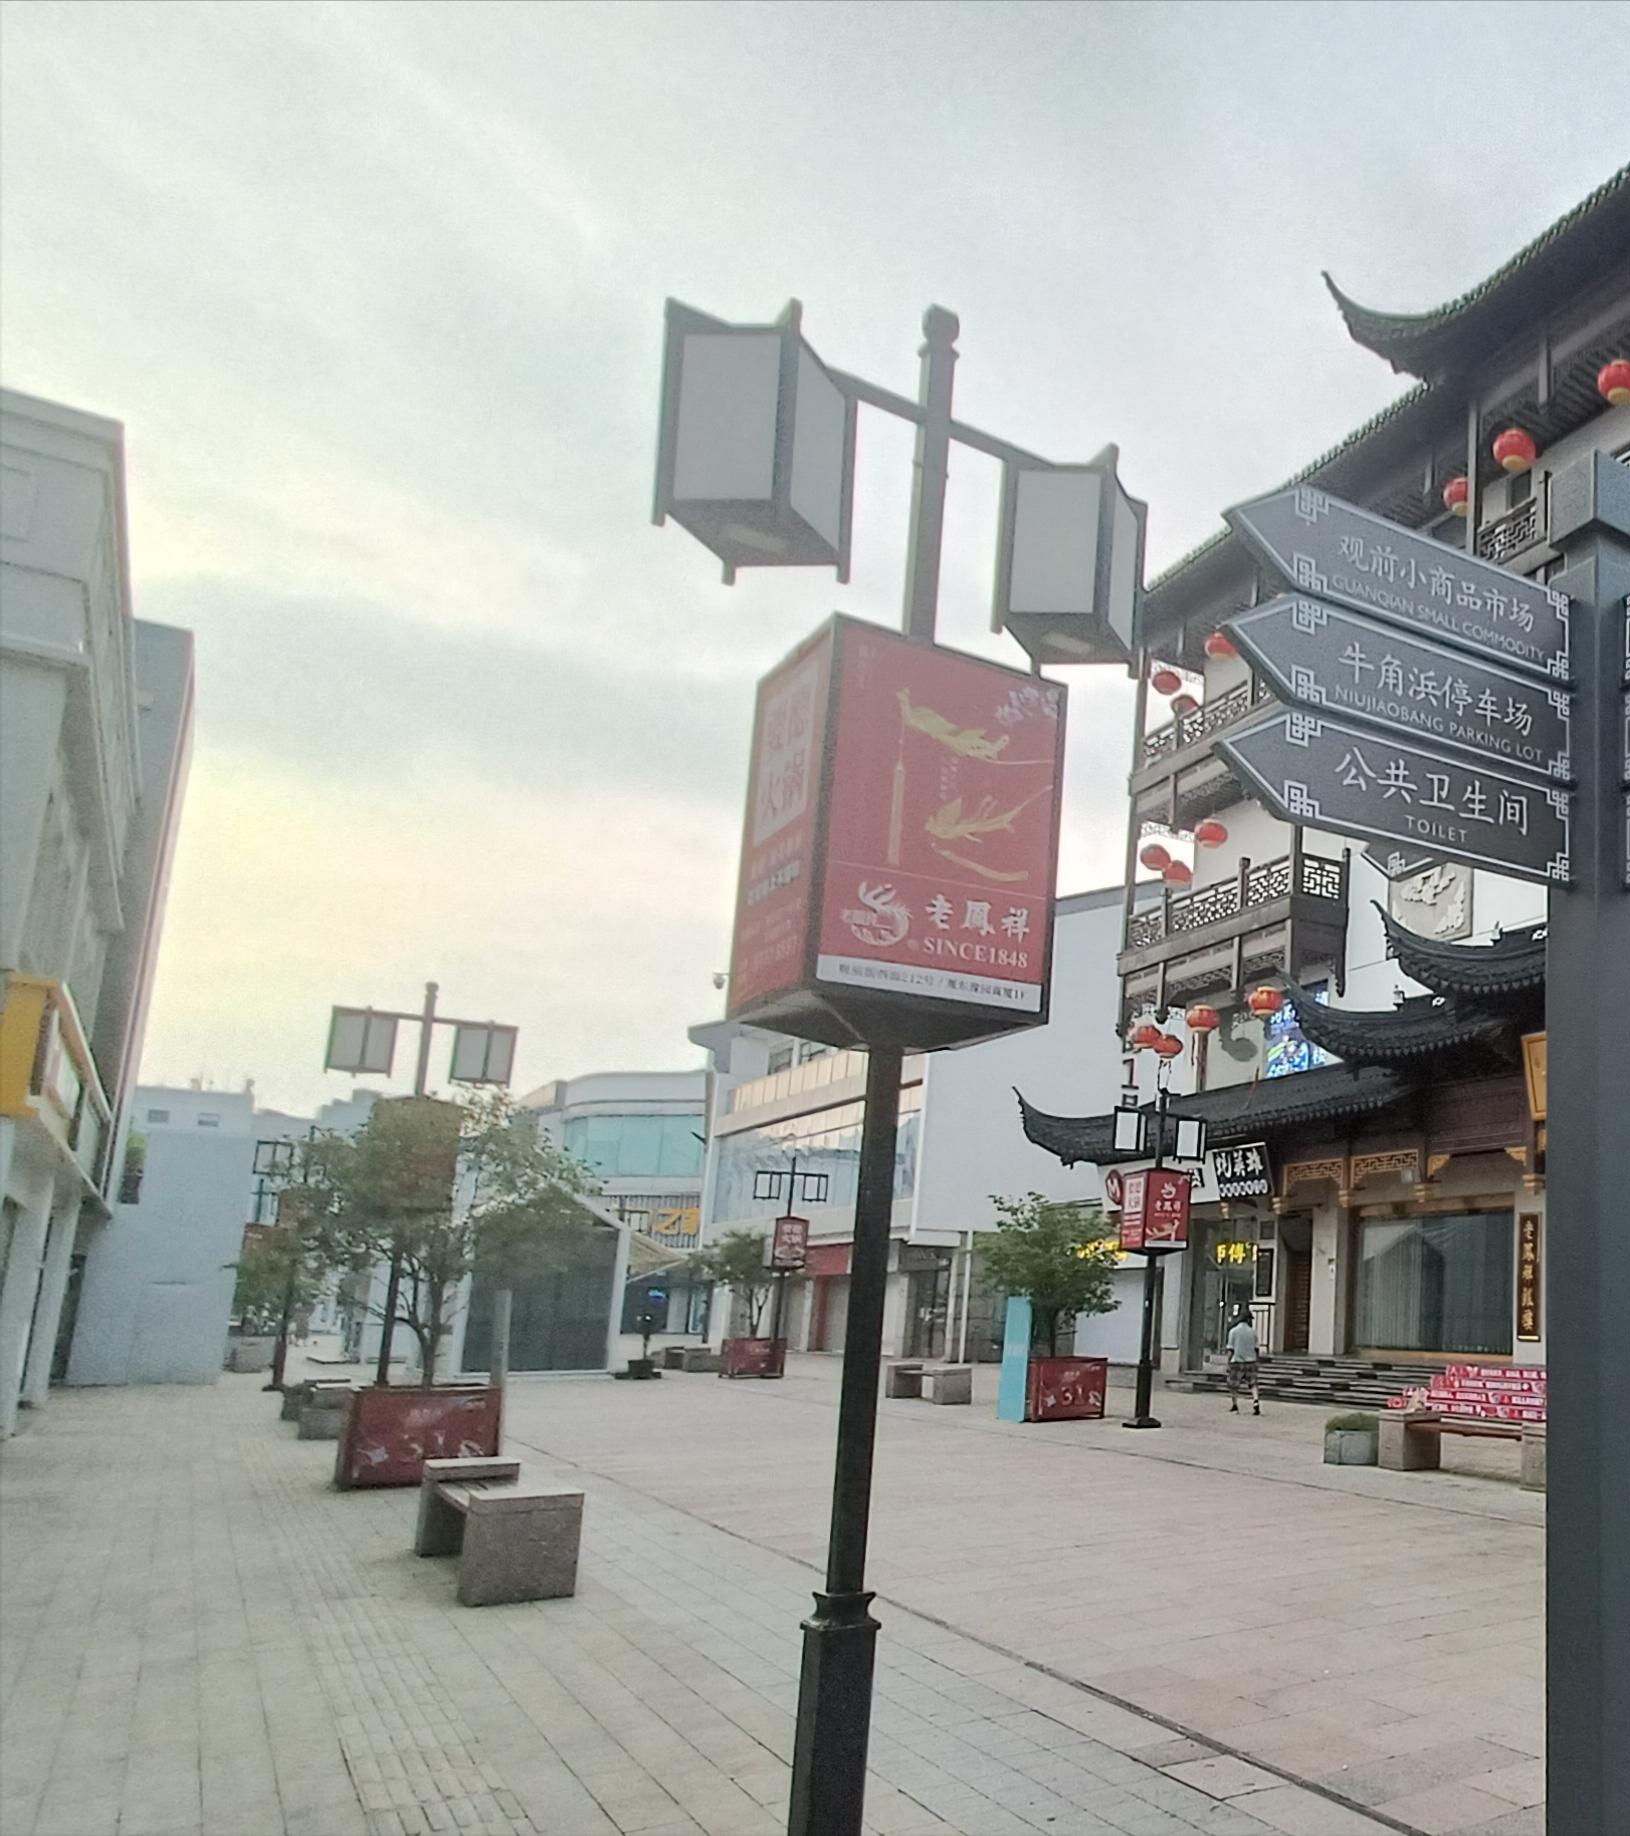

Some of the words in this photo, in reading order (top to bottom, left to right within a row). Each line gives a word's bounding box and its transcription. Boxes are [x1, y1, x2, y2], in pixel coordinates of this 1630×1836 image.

[1332, 575, 1414, 615] GUANQIAN
[1418, 604, 1460, 632] SMALL
[1462, 622, 1545, 661] COMMODITY
[1339, 536, 1535, 633] 观前小商品市场
[1335, 684, 1444, 732] NIUJIAOBANG
[1449, 721, 1511, 754] PARKING
[1516, 742, 1543, 763] LOT
[1338, 641, 1533, 737] 牛角浜停车场
[1334, 746, 1528, 836] 公共卫生间
[1405, 814, 1469, 843] TOILET
